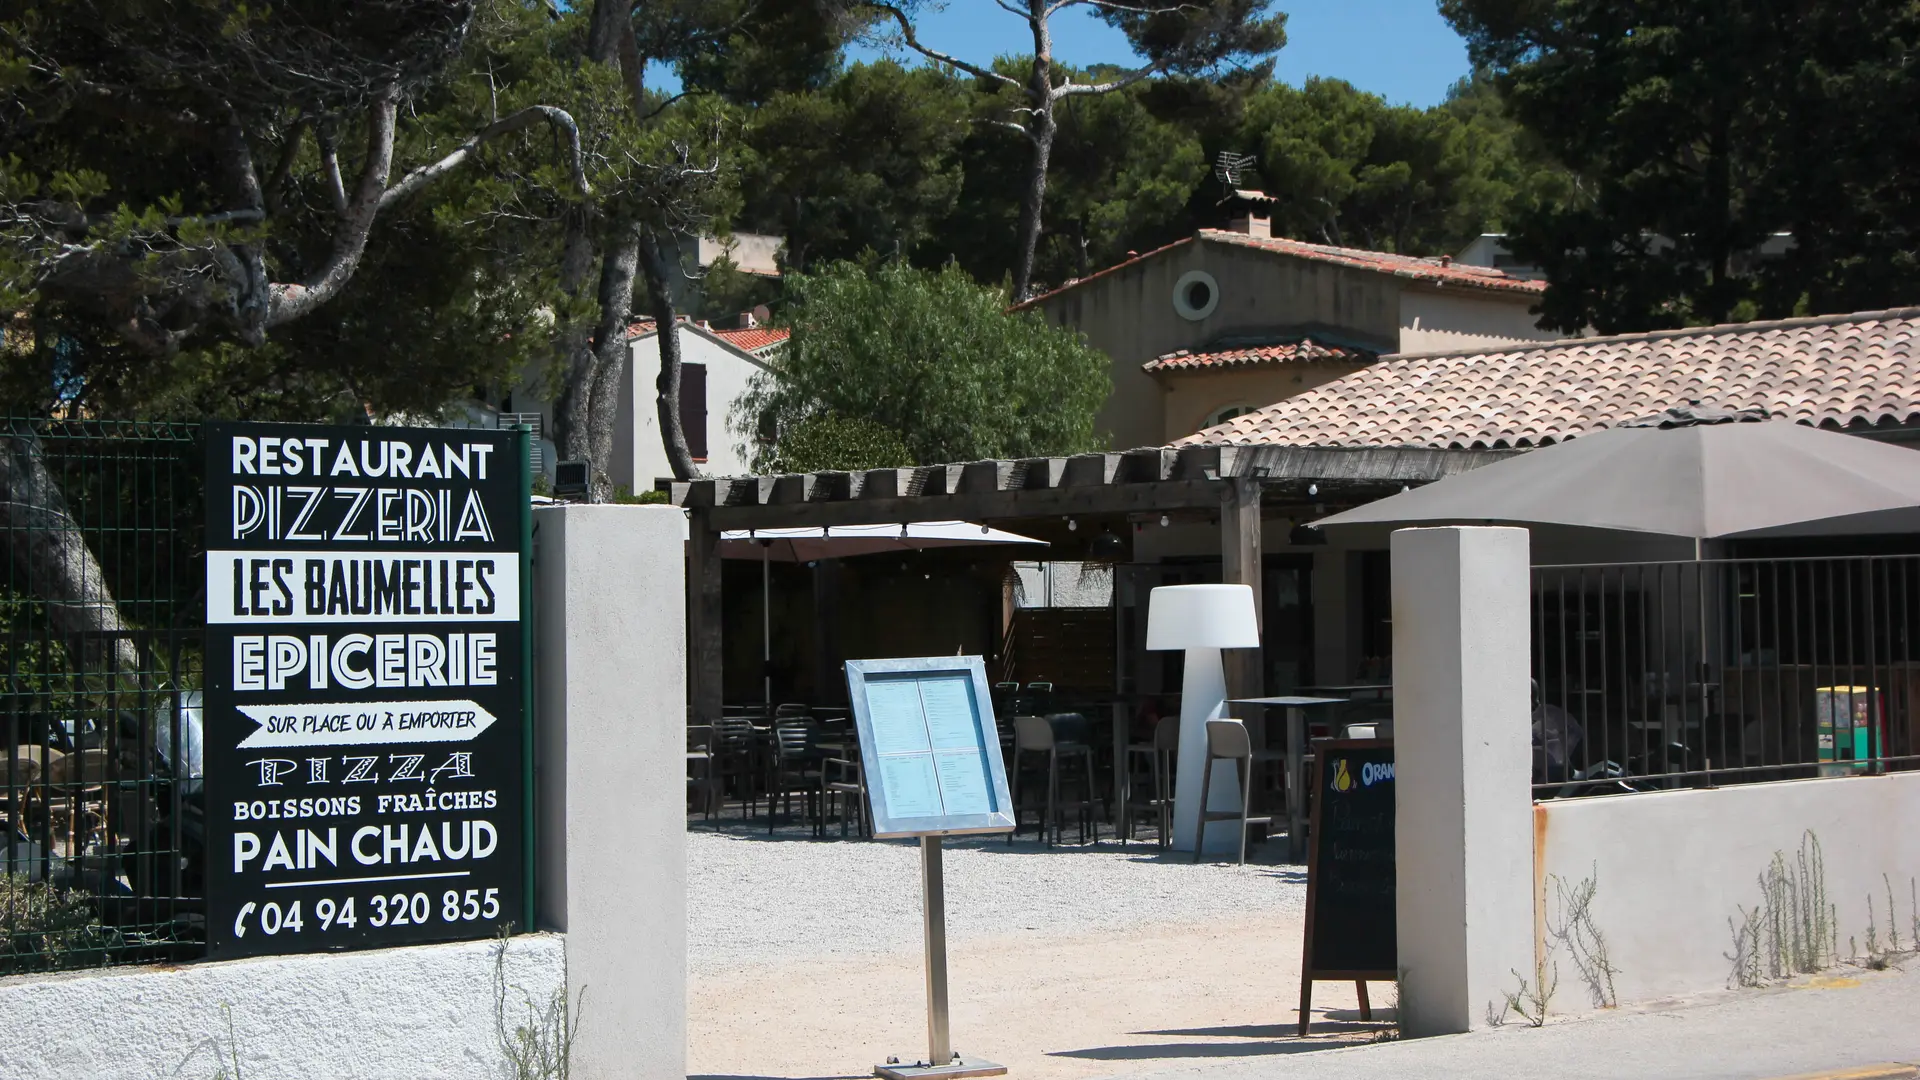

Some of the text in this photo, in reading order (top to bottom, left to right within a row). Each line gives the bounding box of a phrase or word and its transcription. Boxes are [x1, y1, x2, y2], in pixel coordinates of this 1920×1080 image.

[232, 436, 494, 480] RESTAURANT
[232, 484, 495, 545] PIZZERIA
[233, 558, 495, 616] LES BAUMELLES
[233, 633, 498, 691] EPICERIE
[266, 710, 477, 735] SUR PLACE OU À EMPORTER
[245, 751, 475, 786] PIZZA
[233, 788, 498, 820] BOISSONS FRAÎCHES
[233, 820, 498, 873] PAIN CHAUD
[260, 888, 500, 934] 04 94 320 855
